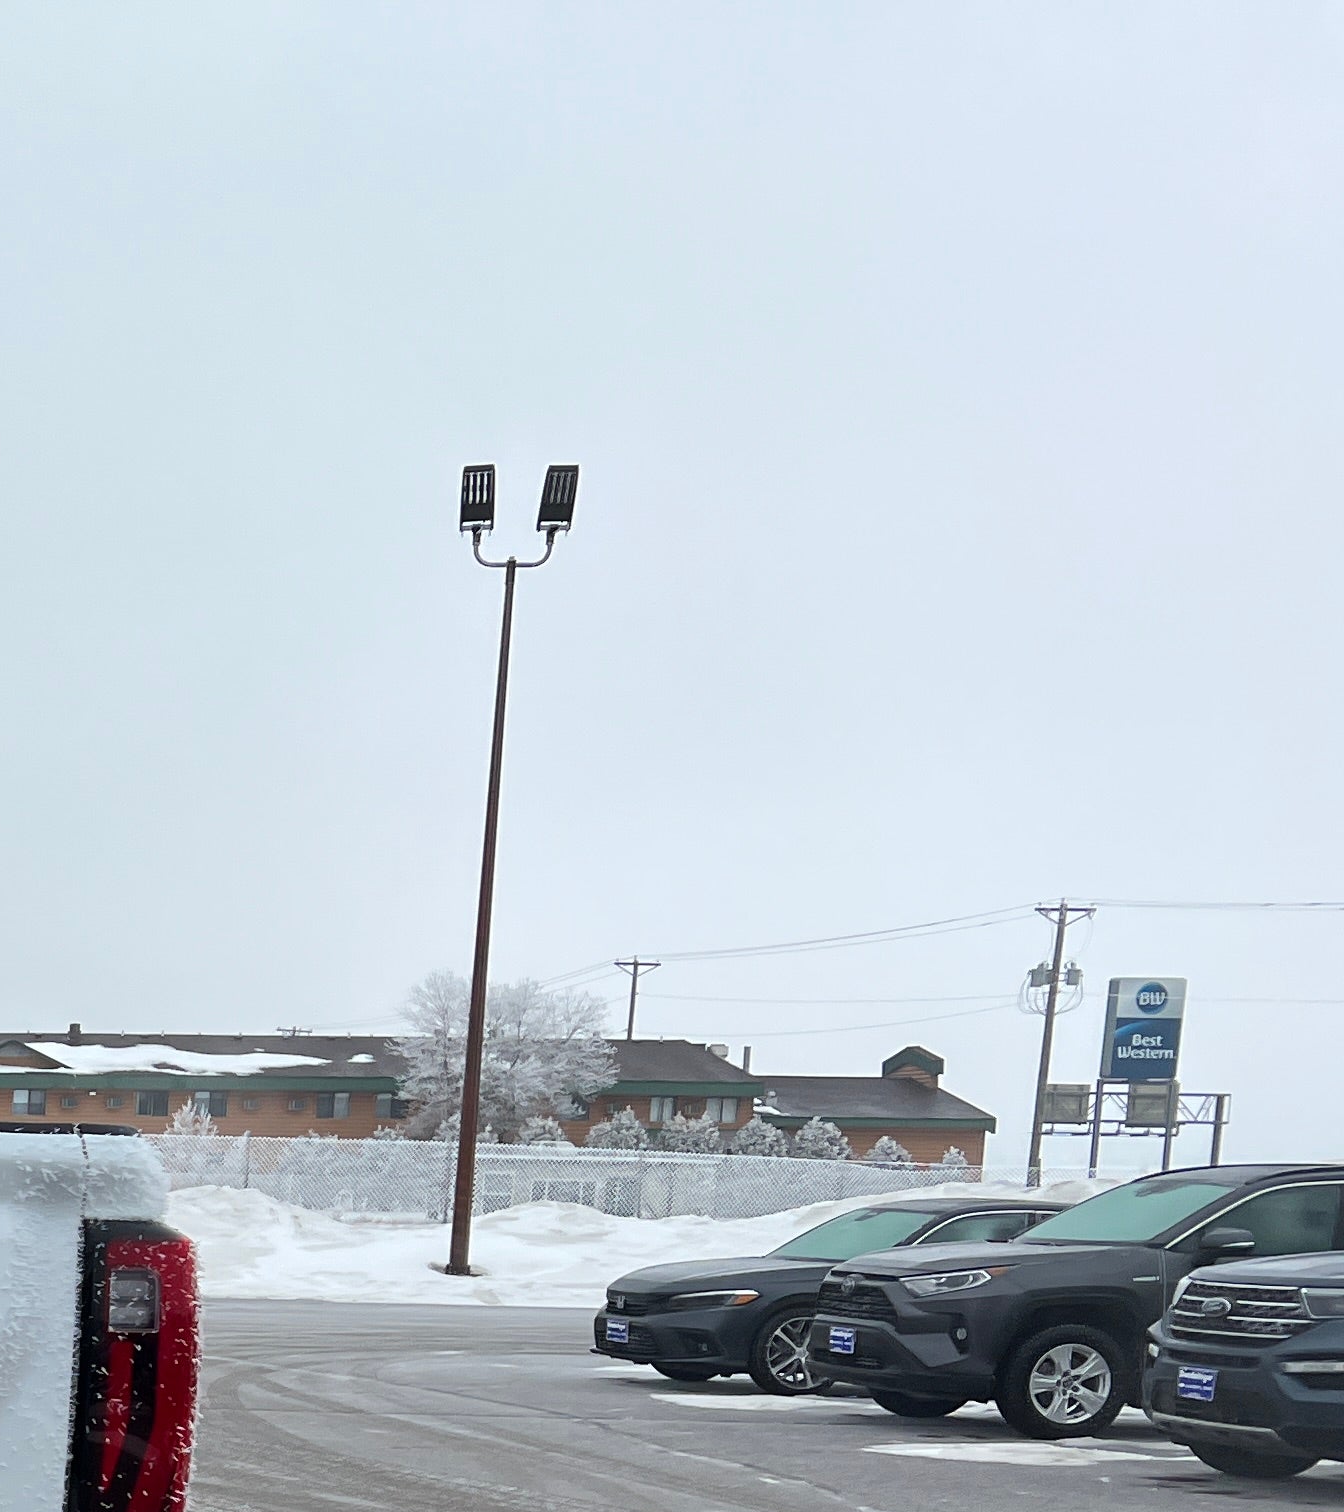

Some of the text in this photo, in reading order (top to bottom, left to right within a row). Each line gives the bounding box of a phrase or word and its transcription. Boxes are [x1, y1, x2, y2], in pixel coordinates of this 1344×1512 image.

[1138, 991, 1166, 1006] BW
[1132, 1034, 1163, 1047] Best
[1117, 1046, 1174, 1059] Western
